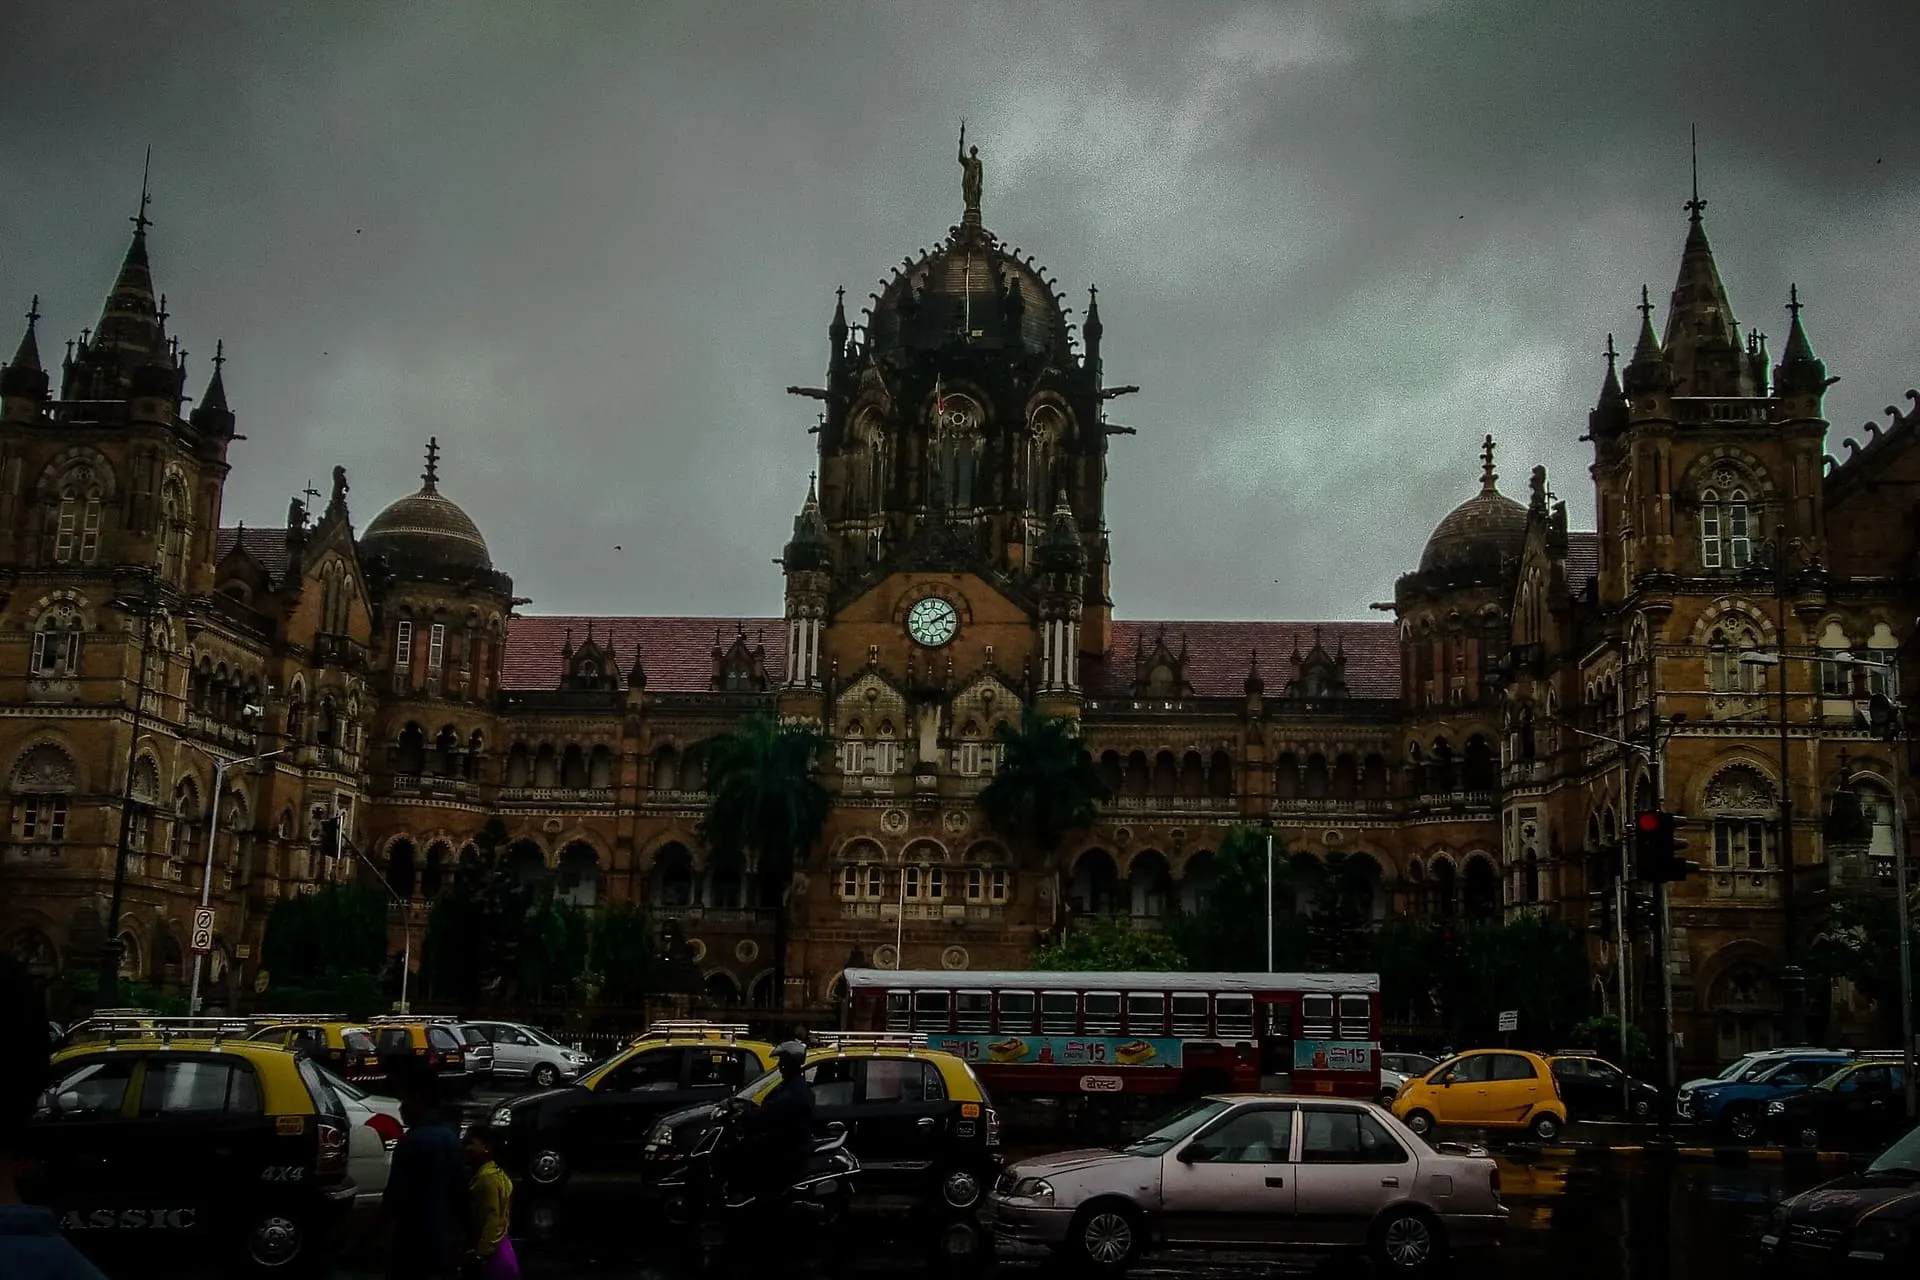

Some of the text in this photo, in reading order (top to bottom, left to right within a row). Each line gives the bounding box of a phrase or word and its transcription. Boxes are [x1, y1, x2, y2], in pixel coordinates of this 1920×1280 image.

[960, 1040, 979, 1058] 15
[1087, 1043, 1105, 1060] 15
[1348, 1048, 1365, 1064] 15
[59, 1207, 197, 1230] ASSIC
